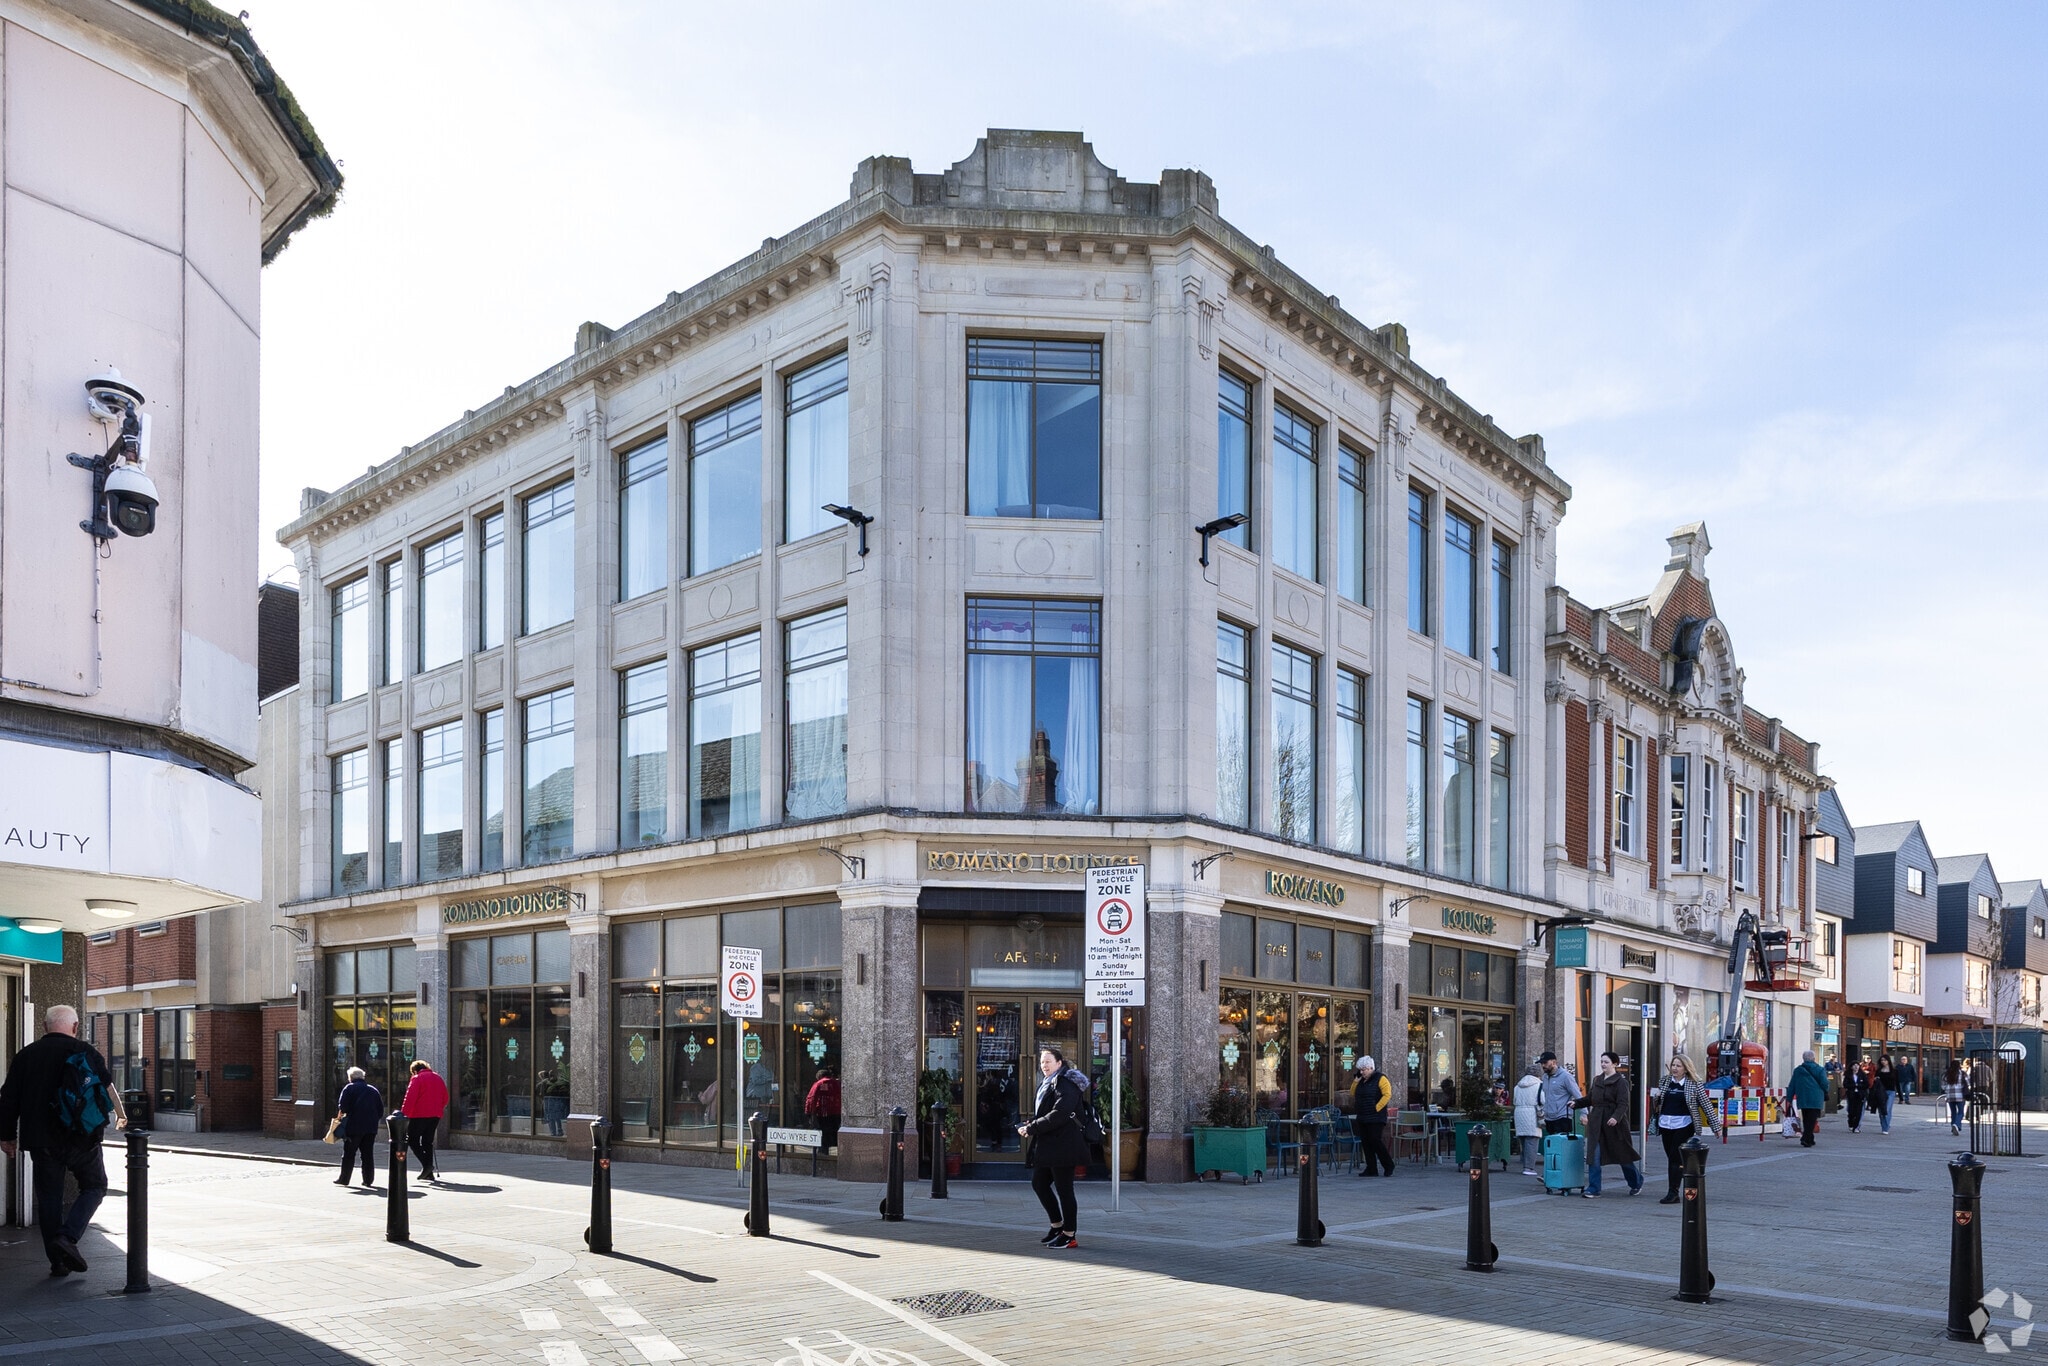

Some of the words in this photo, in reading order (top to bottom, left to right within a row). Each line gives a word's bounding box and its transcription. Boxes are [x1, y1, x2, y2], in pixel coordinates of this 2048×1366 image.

[4, 827, 90, 854] AUTY
[927, 850, 1034, 873] ROMANO
[1092, 868, 1138, 876] PEDESTRIAN
[1098, 884, 1131, 895] ZONE
[1265, 868, 1346, 908] ROMANO
[442, 898, 501, 924] ROMANO
[502, 890, 568, 916] LOUNGE
[729, 961, 755, 970] ZONE
[770, 1131, 786, 1140] LONG
[789, 1132, 807, 1141] WYRE
